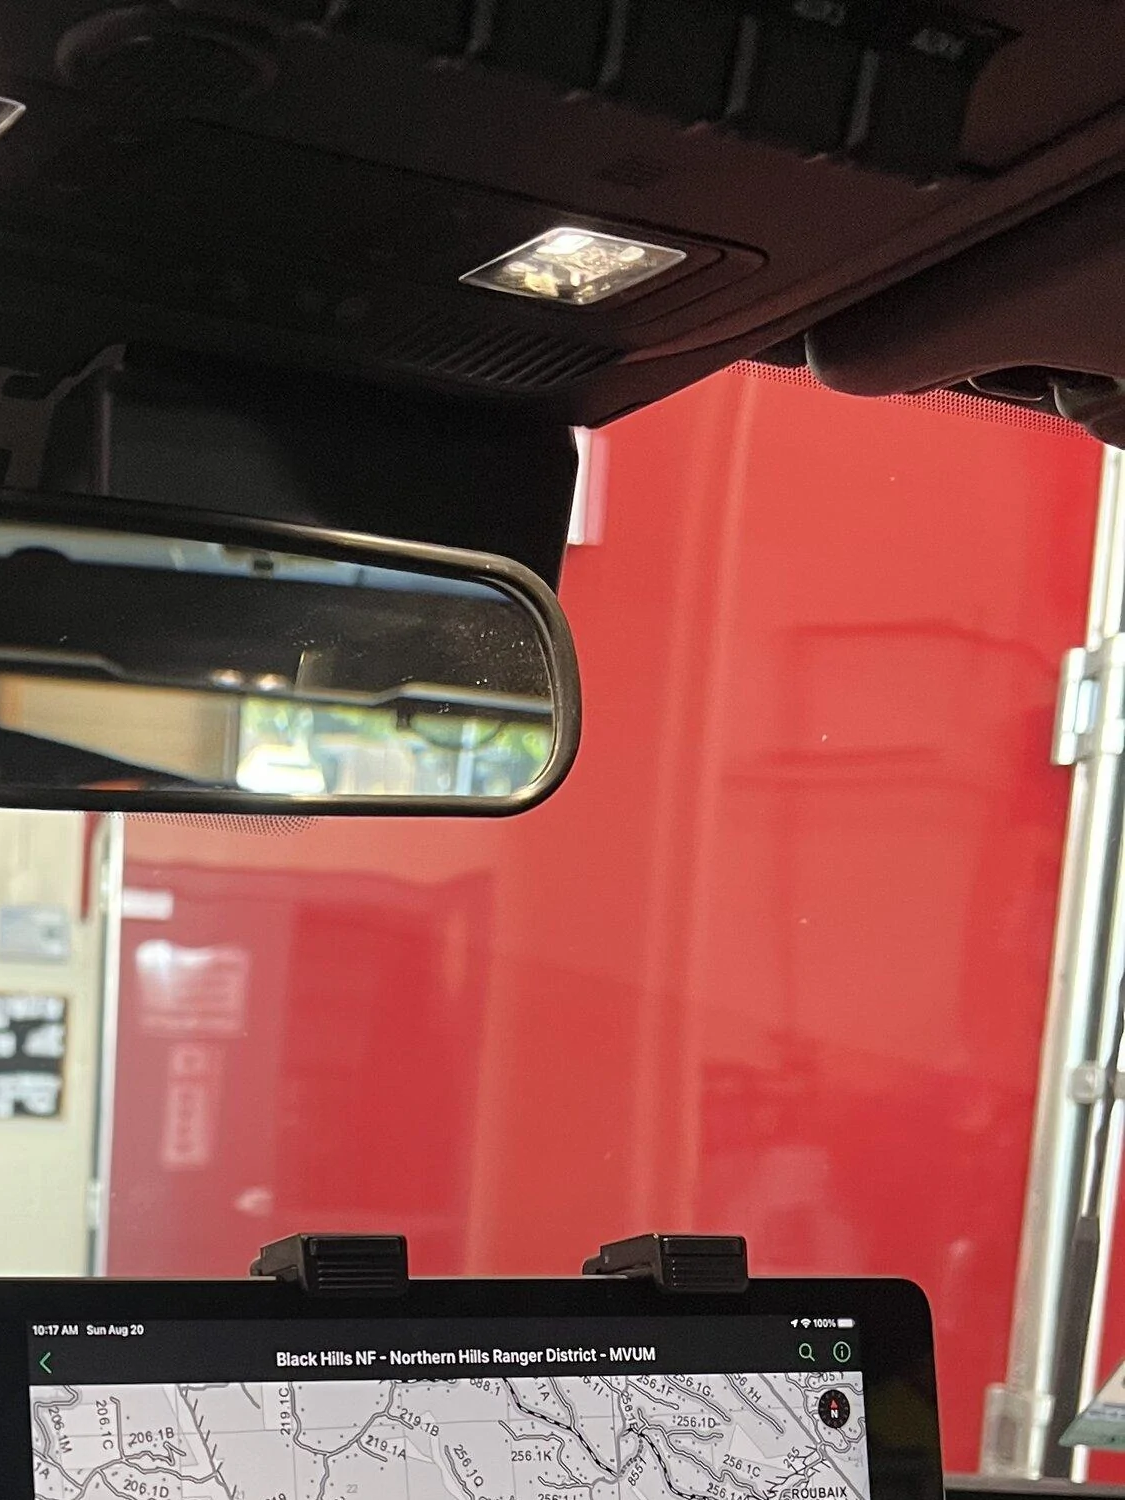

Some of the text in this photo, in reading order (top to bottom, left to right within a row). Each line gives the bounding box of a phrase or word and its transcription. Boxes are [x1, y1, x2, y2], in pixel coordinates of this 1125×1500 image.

[32, 1324, 145, 1338] 10:17 AM Sun Aug 20
[813, 1318, 837, 1329] 100%
[276, 1351, 318, 1367] Black
[320, 1350, 353, 1366] Hills
[355, 1350, 377, 1366] NF
[389, 1350, 456, 1365] Northern
[458, 1348, 490, 1364] Hills
[492, 1348, 544, 1367] Ranger
[546, 1347, 597, 1363] District
[609, 1346, 656, 1362] MVUM
[278, 1387, 291, 1436] 219.1C
[48, 1406, 73, 1455] 206.1M
[96, 1400, 114, 1450] 206.1C
[399, 1408, 439, 1437] 219.1B
[677, 1416, 716, 1429] 256.1D
[127, 1427, 175, 1448] 206.1B
[365, 1434, 407, 1460] 219.1A
[511, 1451, 552, 1462] 256.1K
[783, 1446, 800, 1469] 255
[123, 1478, 170, 1499] 206.1D
[791, 1486, 847, 1500] ROUBAIX
